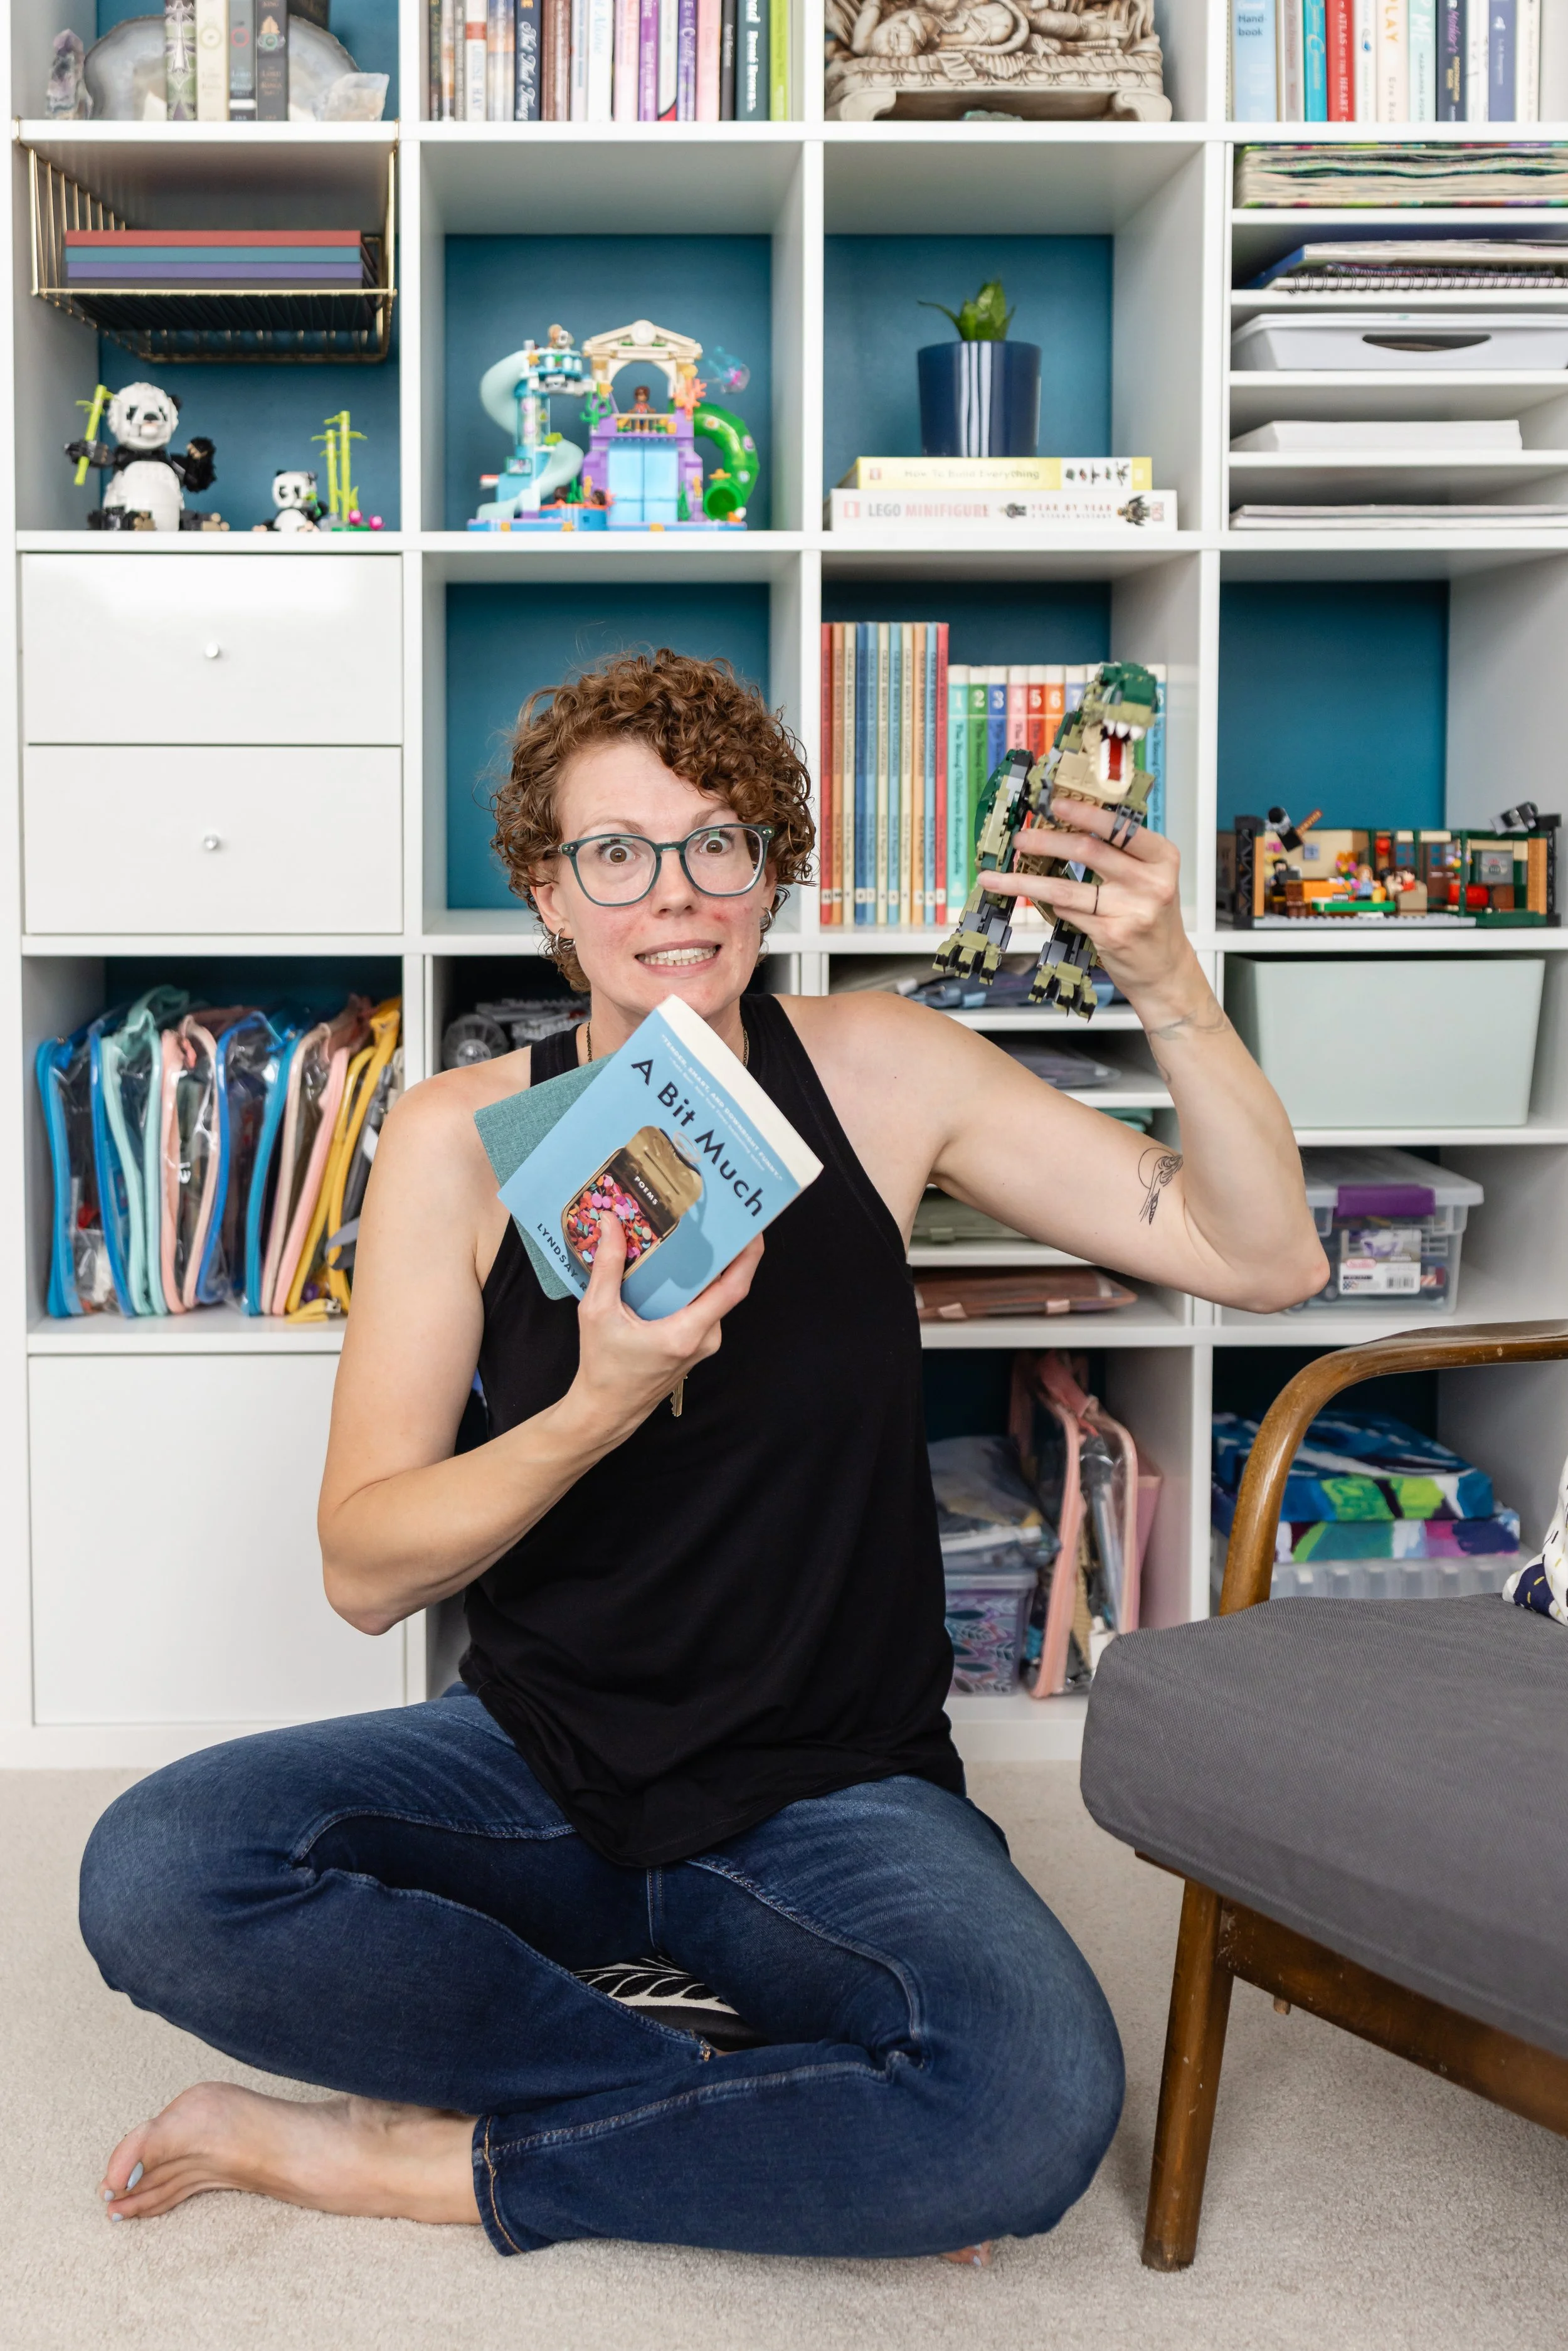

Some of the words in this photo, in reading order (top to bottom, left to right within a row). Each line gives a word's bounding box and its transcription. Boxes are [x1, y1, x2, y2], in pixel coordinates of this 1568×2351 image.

[1237, 27, 1263, 36] book
[1338, 11, 1348, 45] ATLAS
[1339, 77, 1348, 113] HEART
[904, 470, 927, 478] How
[933, 470, 943, 478] To
[979, 469, 1040, 480] Everything
[868, 503, 901, 517] LEGO
[904, 503, 991, 517] MINIFIGURE
[955, 691, 963, 708] 1
[973, 689, 985, 708] 2
[992, 690, 1004, 709] 3
[1014, 690, 1023, 708] 4
[1031, 689, 1042, 708] 5
[1050, 690, 1061, 709] 6
[955, 723, 963, 740] The
[954, 742, 963, 768] Young
[955, 769, 963, 814] Children's
[711, 1093, 724, 1108] AND
[724, 1108, 760, 1151] DOWNRIGHT
[630, 1059, 654, 1086] A
[657, 1081, 697, 1127] Bit
[694, 1129, 765, 1218] Much
[634, 1176, 659, 1206] POEMS
[536, 1223, 579, 1278] LYNDSAY
